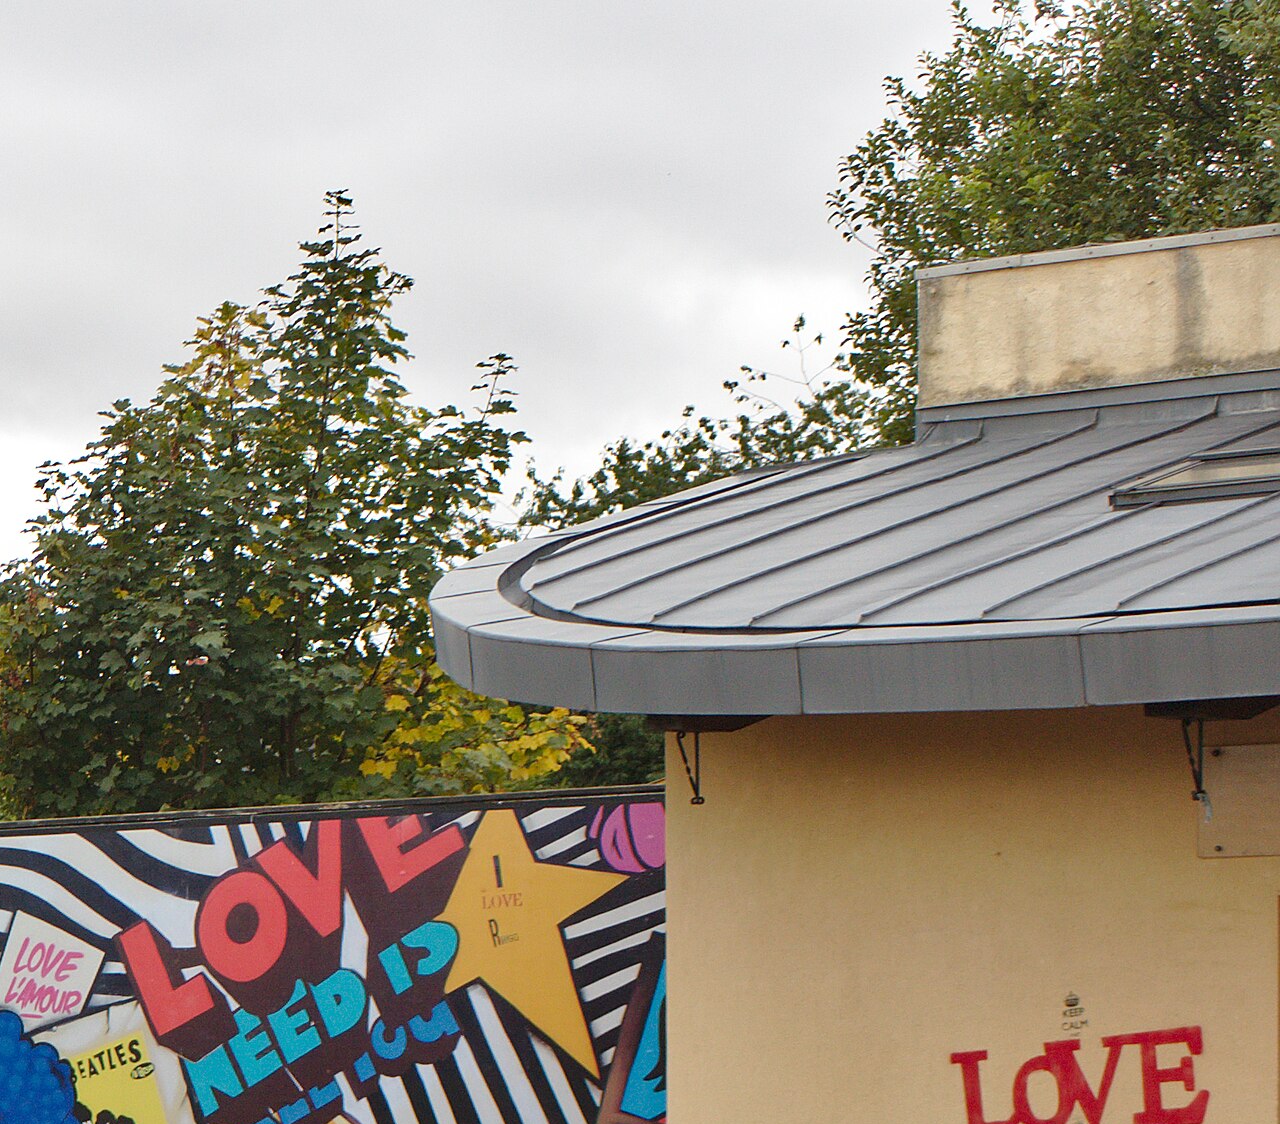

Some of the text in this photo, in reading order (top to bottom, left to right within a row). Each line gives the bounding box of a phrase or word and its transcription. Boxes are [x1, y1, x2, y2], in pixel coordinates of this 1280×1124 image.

[481, 892, 524, 910] LOVE
[120, 813, 465, 1037] LOVE
[13, 936, 85, 982] LOVE
[4, 976, 83, 1015] L'AMOUR
[71, 1039, 142, 1084] EATLES
[184, 968, 366, 1118] NEED
[354, 1000, 460, 1082] OU
